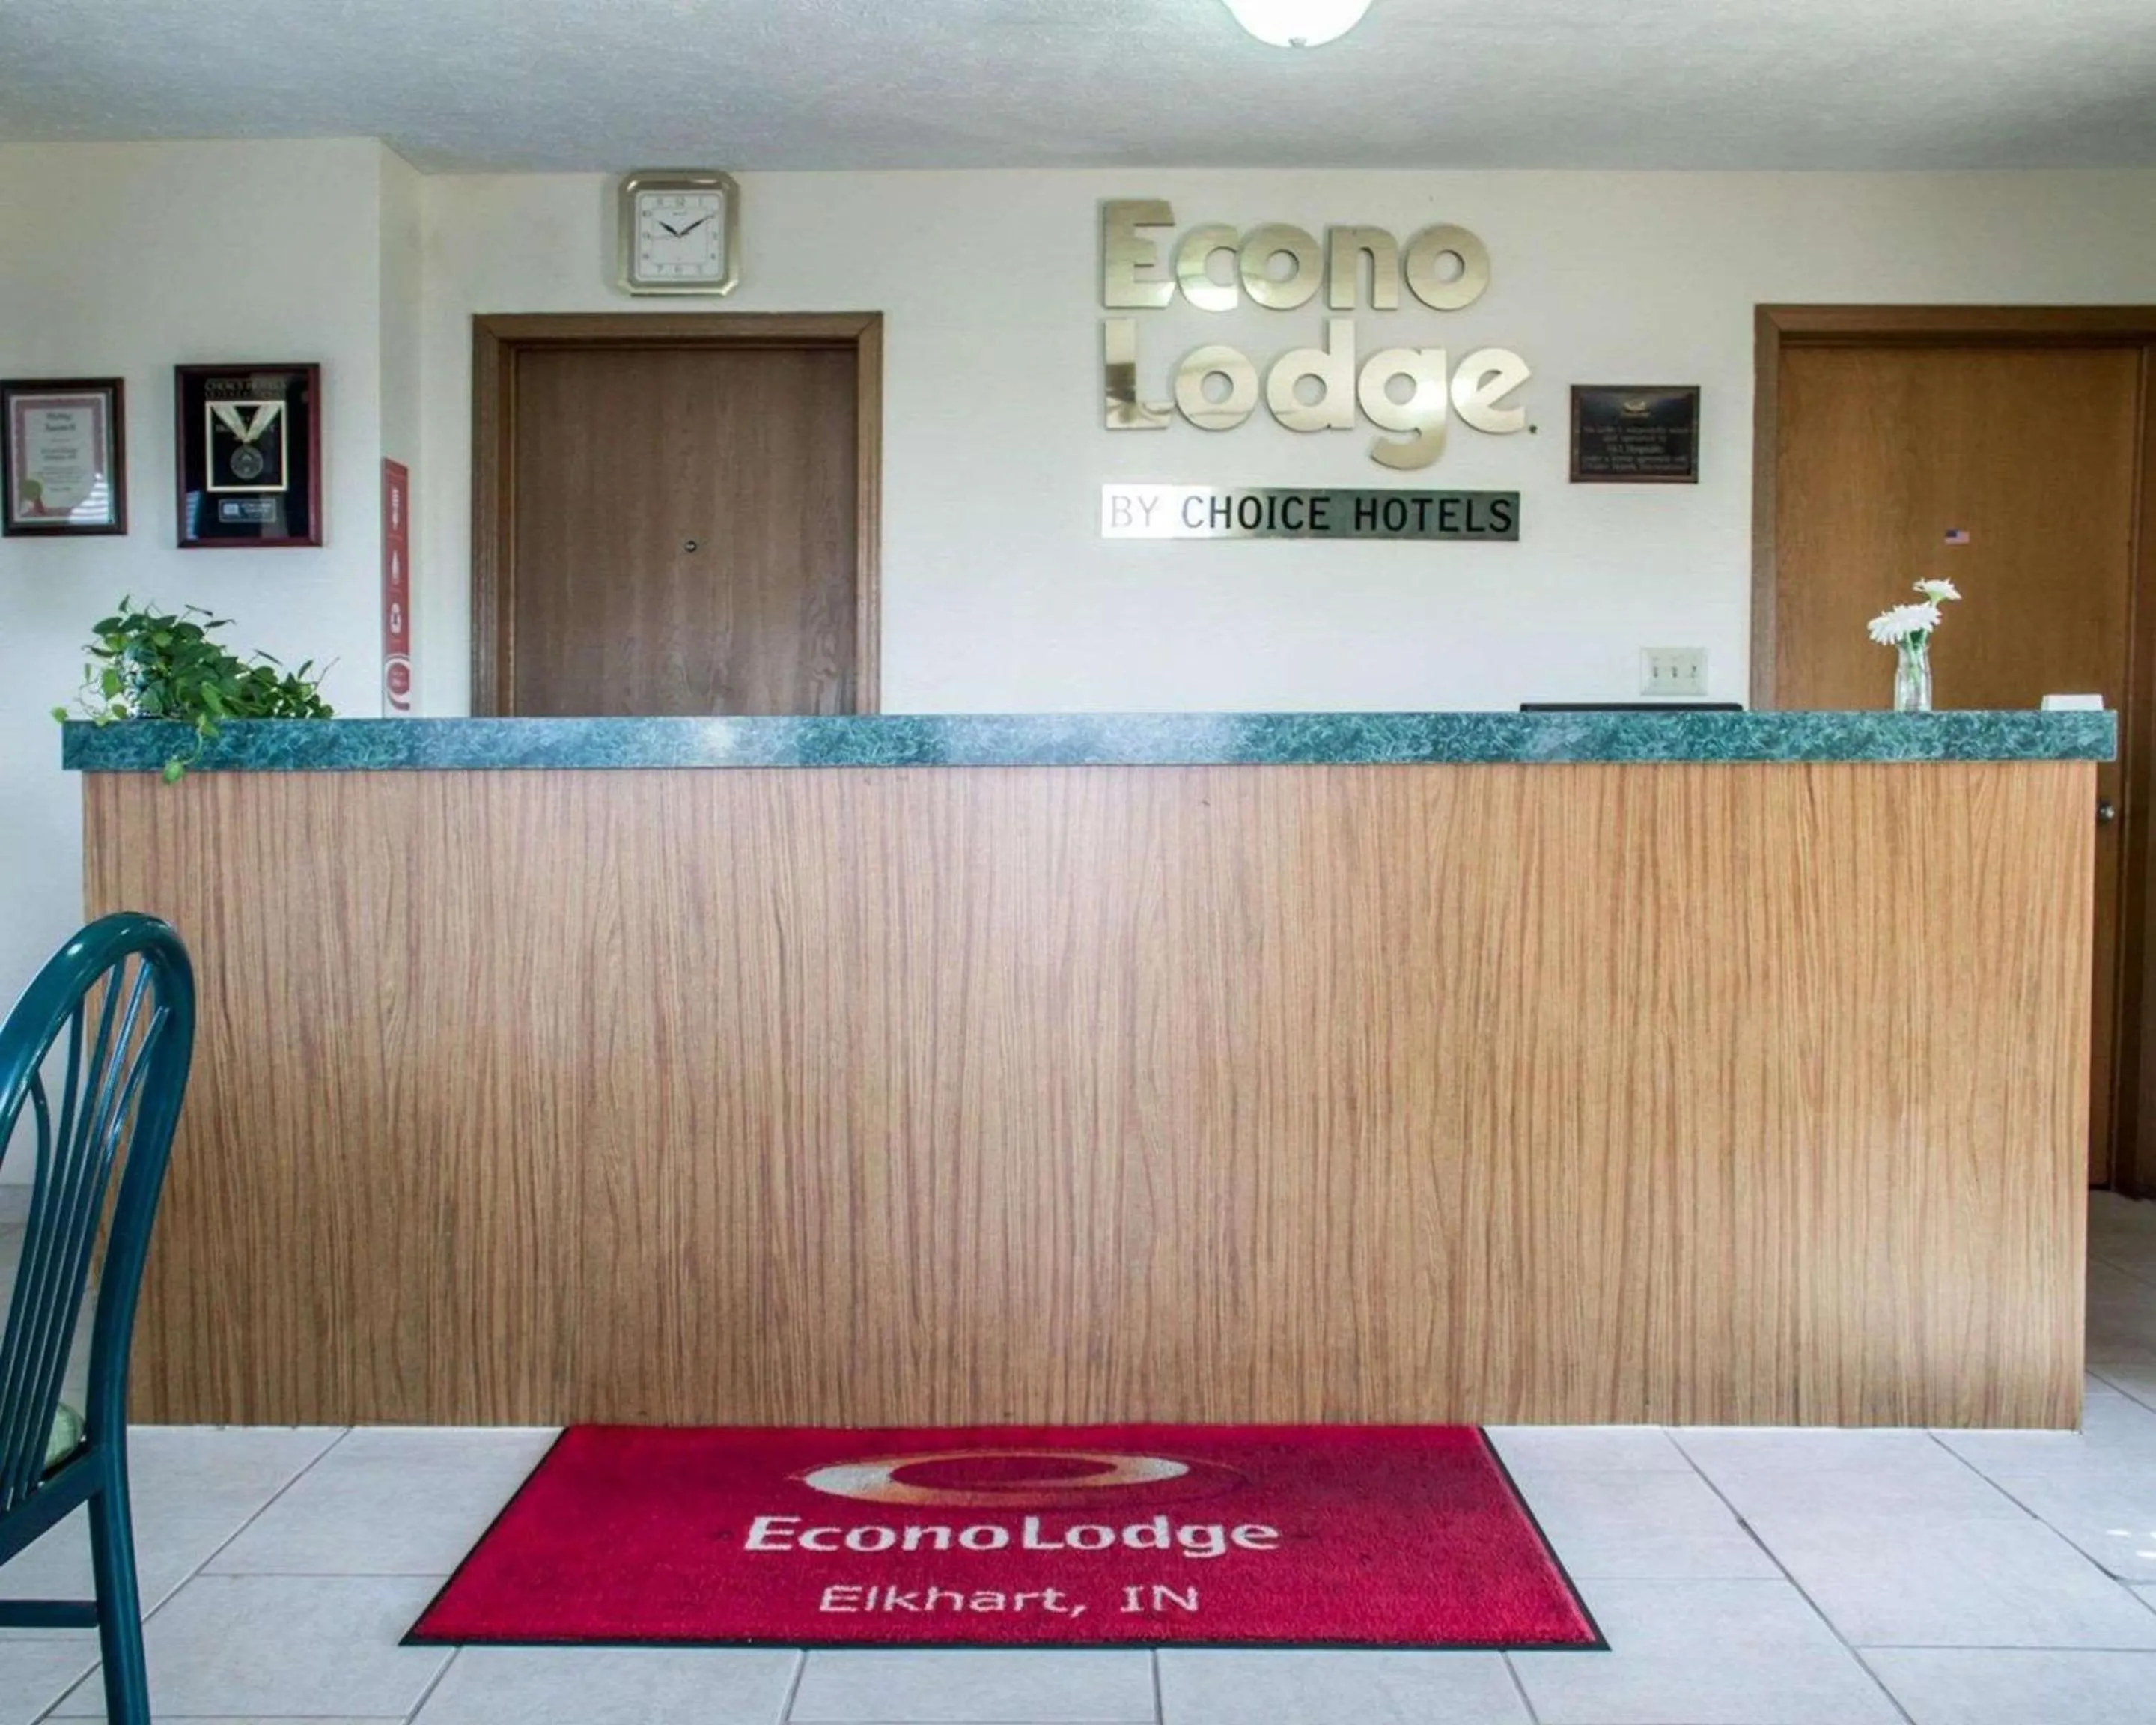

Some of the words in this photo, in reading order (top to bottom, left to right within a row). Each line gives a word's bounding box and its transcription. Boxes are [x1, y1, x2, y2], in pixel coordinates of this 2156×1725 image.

[1103, 199, 1490, 311] Econo
[1111, 496, 1159, 528] BY
[1181, 496, 1331, 531] CHOICE
[1354, 497, 1512, 533] HOTELS
[744, 1515, 1279, 1557] EconoLodge
[819, 1584, 1088, 1618] Elkhart,
[1120, 1585, 1199, 1612] IN
